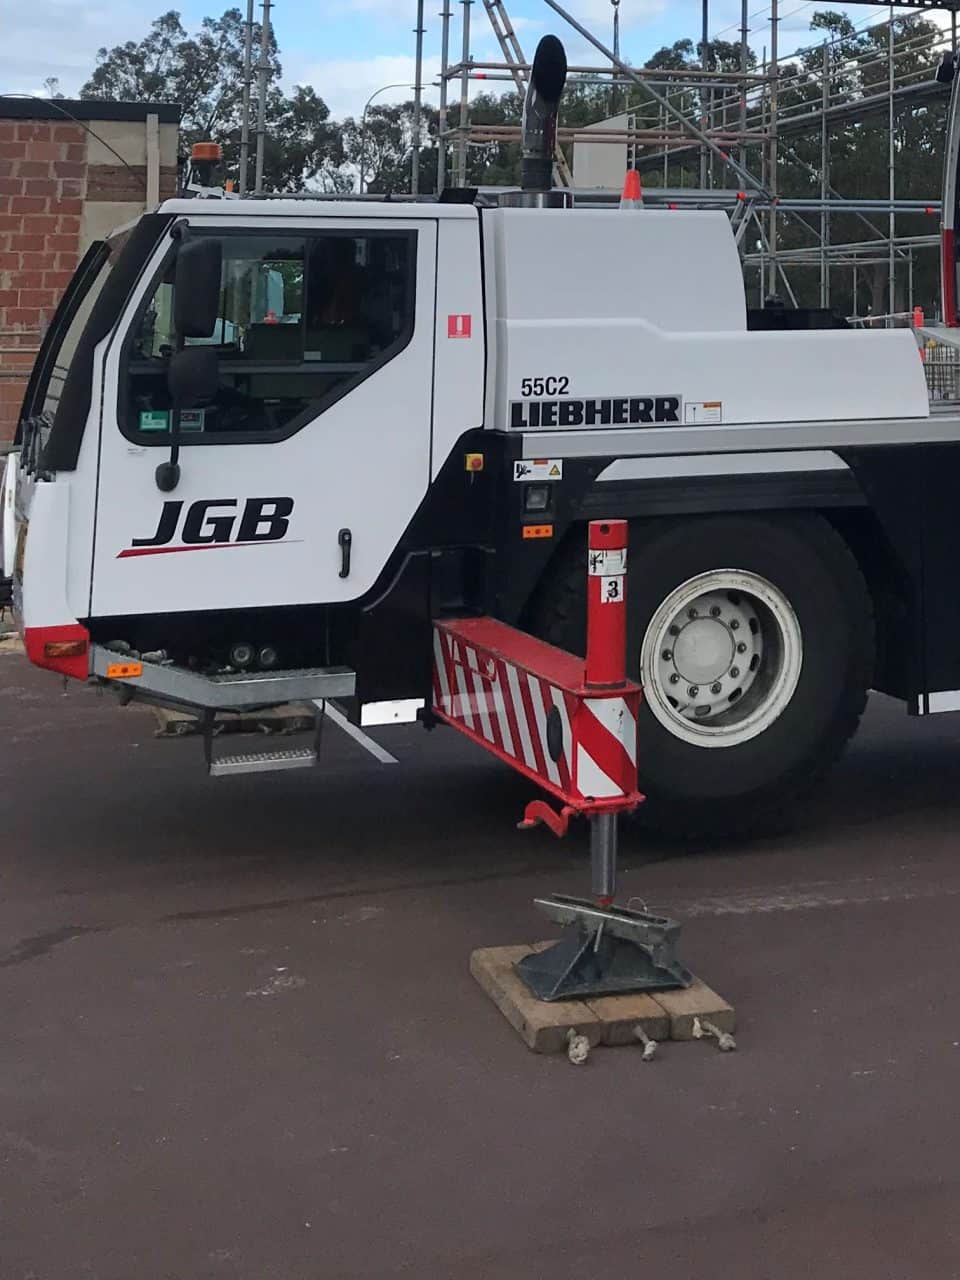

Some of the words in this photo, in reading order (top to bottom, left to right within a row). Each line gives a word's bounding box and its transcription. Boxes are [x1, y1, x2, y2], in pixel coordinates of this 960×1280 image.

[521, 376, 570, 397] 55C2
[511, 397, 680, 428] LIEBHERR
[131, 496, 294, 547] JGB
[607, 580, 619, 598] 3
